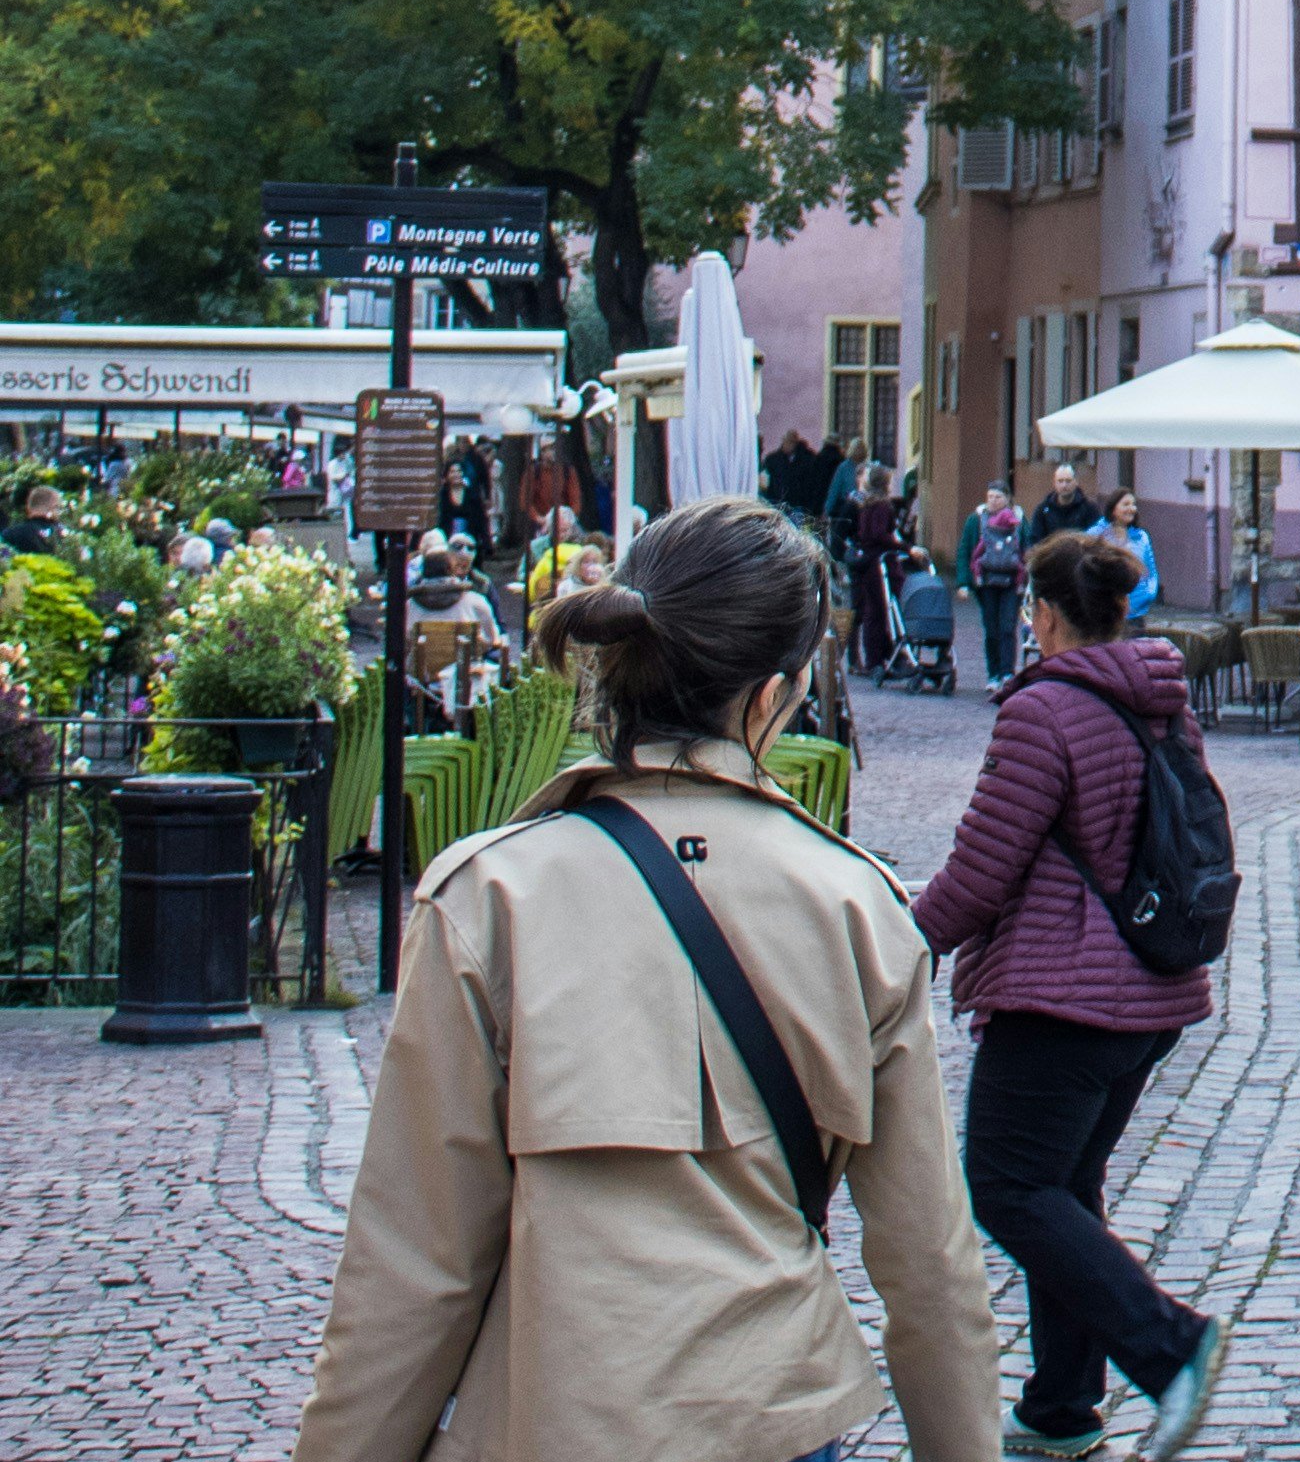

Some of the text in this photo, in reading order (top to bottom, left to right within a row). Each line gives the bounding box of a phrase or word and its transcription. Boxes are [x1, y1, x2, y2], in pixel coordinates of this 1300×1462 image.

[397, 224, 487, 247] Montagne
[492, 226, 541, 245] Verte
[363, 254, 541, 276] Pôle Média-Culture
[101, 361, 253, 399] Schwendi
